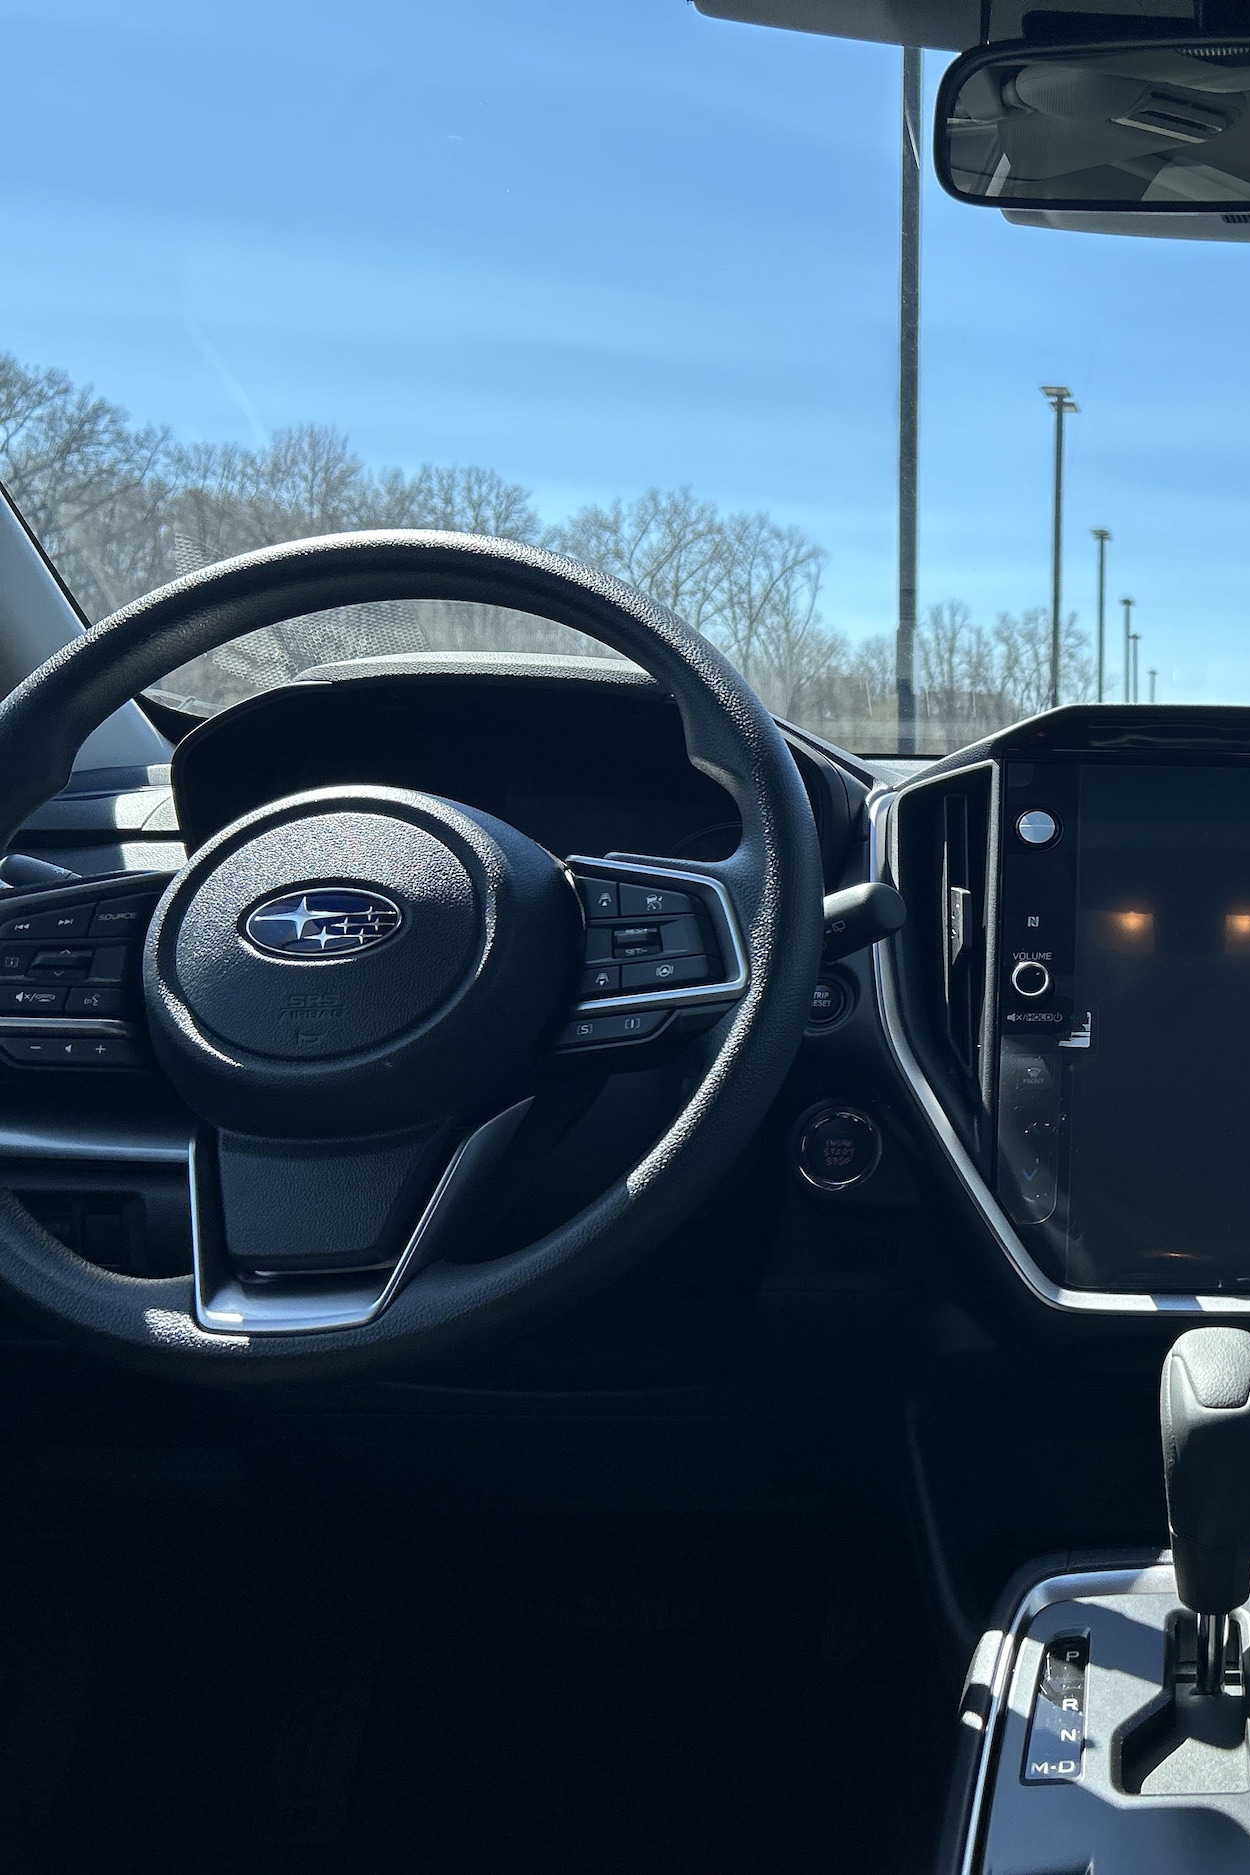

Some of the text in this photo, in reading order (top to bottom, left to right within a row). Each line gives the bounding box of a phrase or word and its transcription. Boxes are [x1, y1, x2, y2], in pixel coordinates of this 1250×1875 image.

[99, 912, 138, 921] SOURCE
[1013, 952, 1052, 960] VOLUME
[813, 999, 832, 1007] ESET
[1066, 1651, 1080, 1662] P
[1062, 1698, 1078, 1712] R
[1060, 1728, 1077, 1742] N
